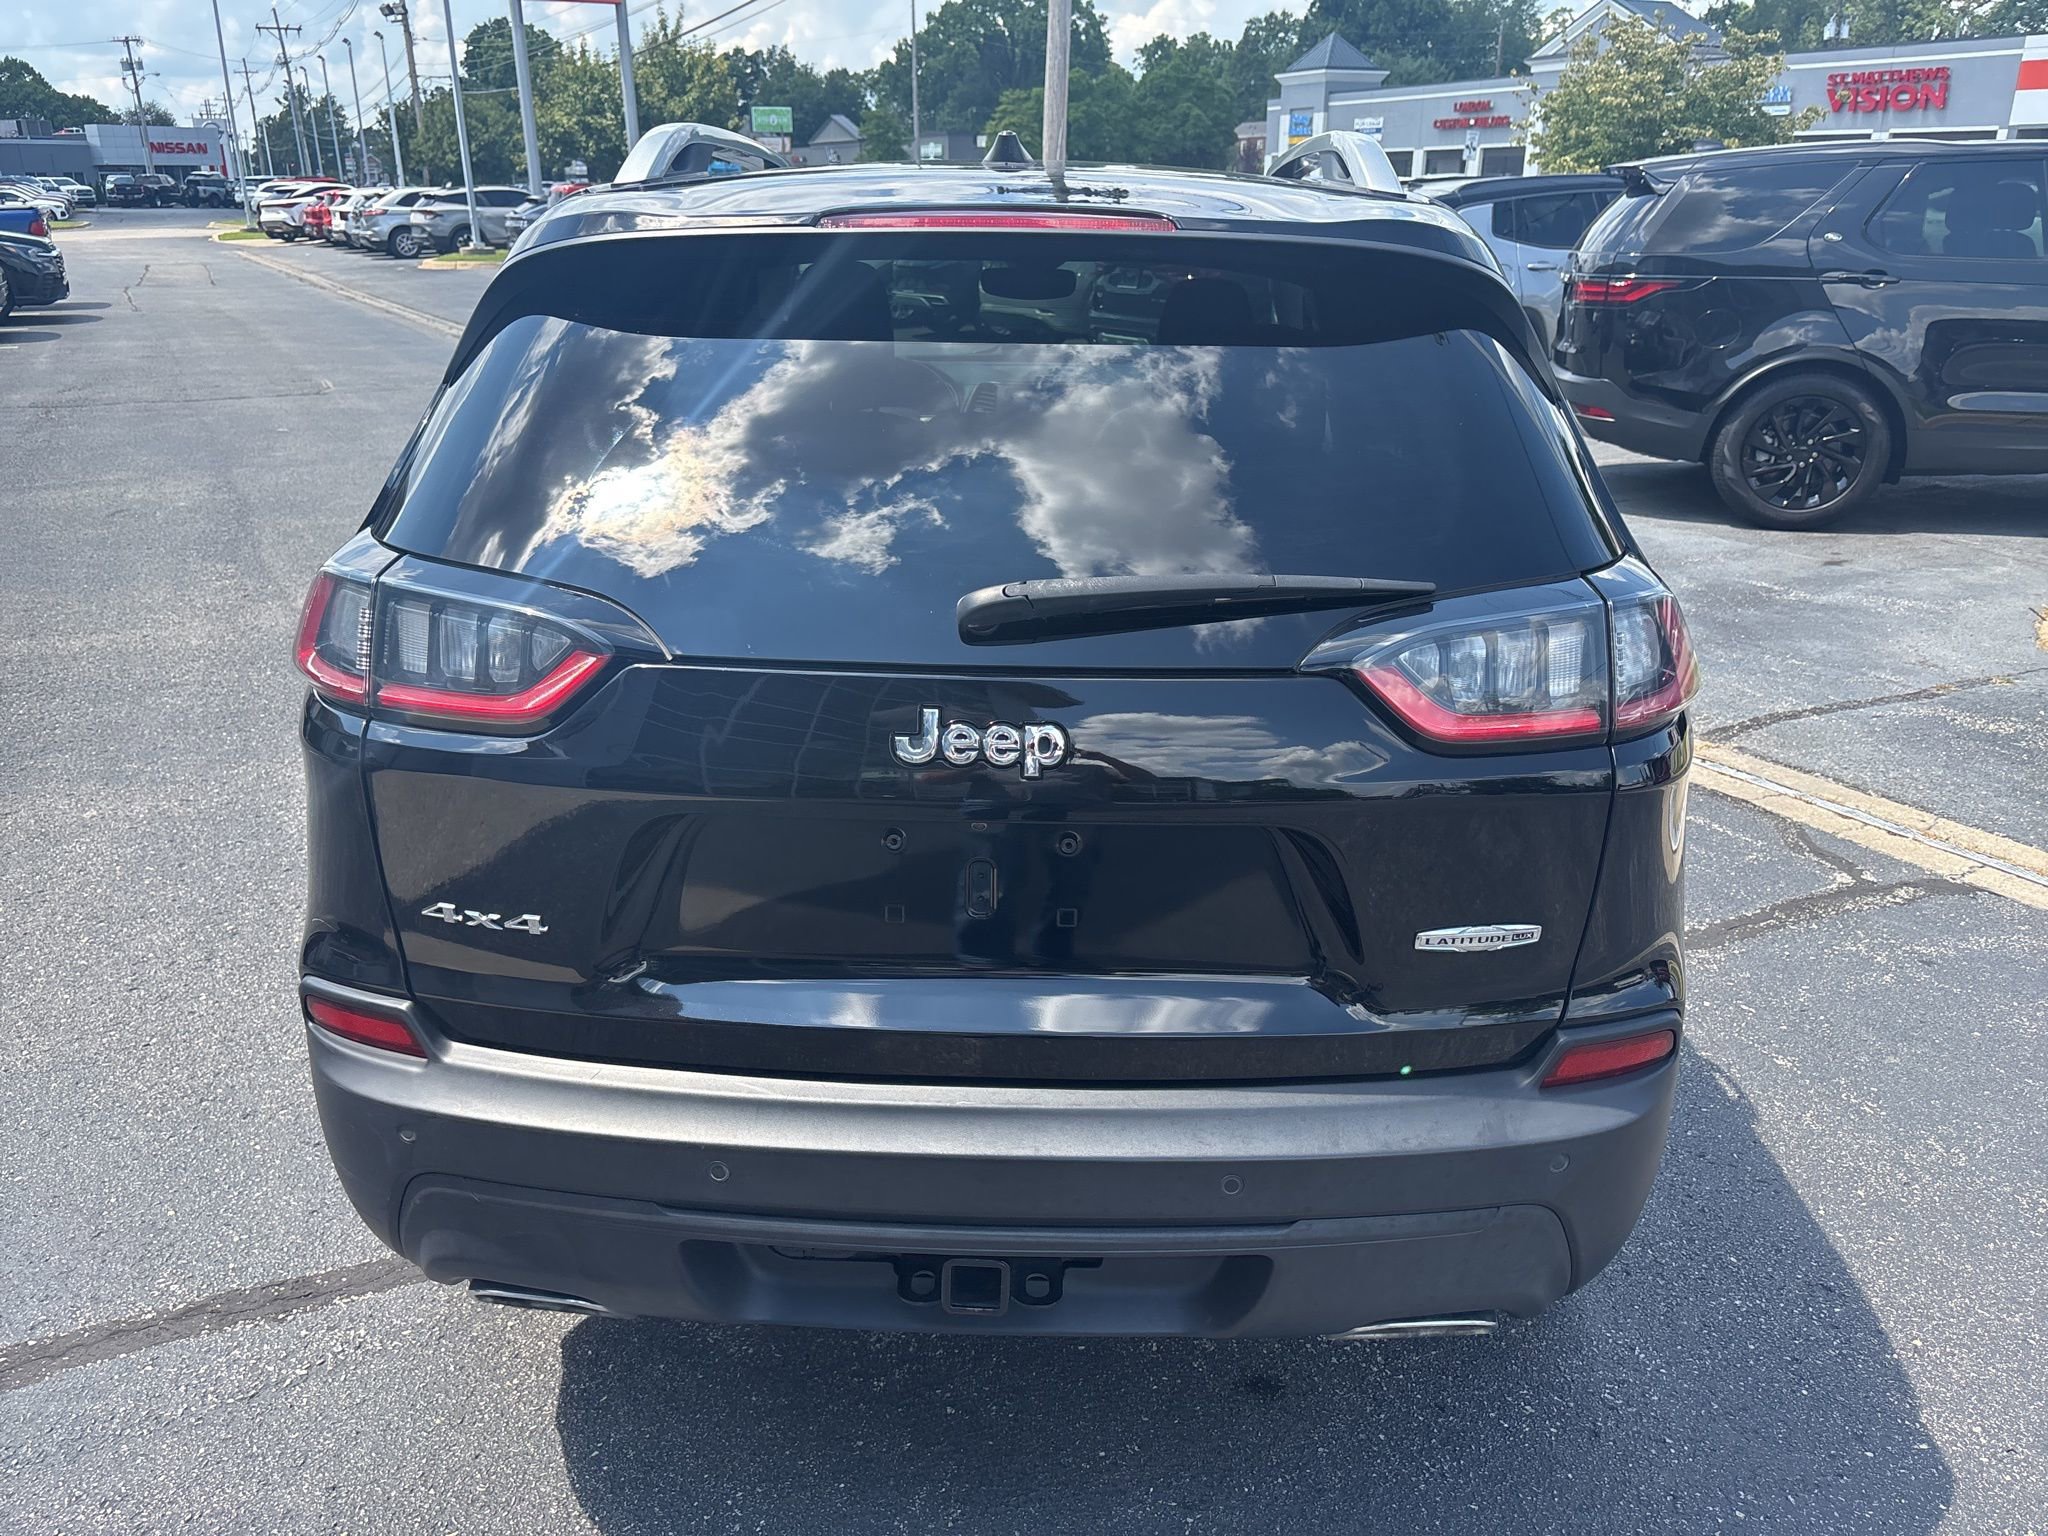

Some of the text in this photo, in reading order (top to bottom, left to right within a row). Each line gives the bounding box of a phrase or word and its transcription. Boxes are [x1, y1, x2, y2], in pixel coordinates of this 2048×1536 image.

[1852, 67, 1950, 84] MATTHEWS
[1826, 83, 1949, 113] VISION
[149, 142, 208, 154] NISSAN
[894, 707, 1066, 778] Jeep
[421, 902, 549, 935] 4x4
[1424, 931, 1534, 946] LATITUDE LUX
